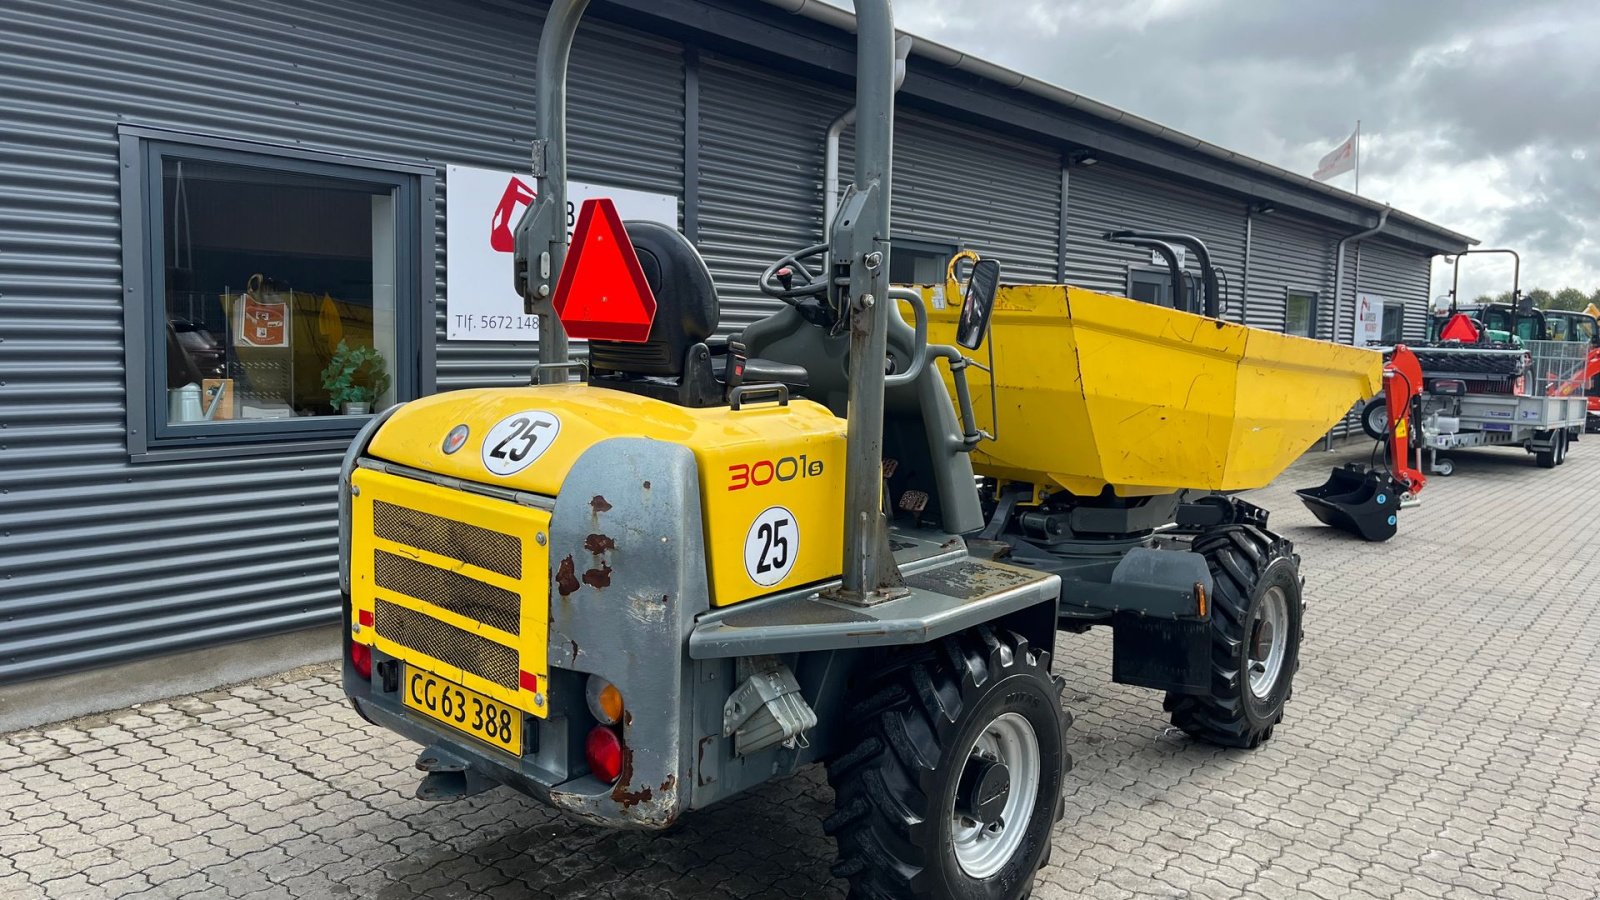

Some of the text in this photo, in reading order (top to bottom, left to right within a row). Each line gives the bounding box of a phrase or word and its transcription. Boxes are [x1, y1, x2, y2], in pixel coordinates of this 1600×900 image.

[455, 314, 476, 332] Tlf.
[481, 315, 513, 329] 5672
[489, 417, 552, 462] 25
[756, 518, 789, 574] 25
[411, 673, 512, 744] CG 63 388
